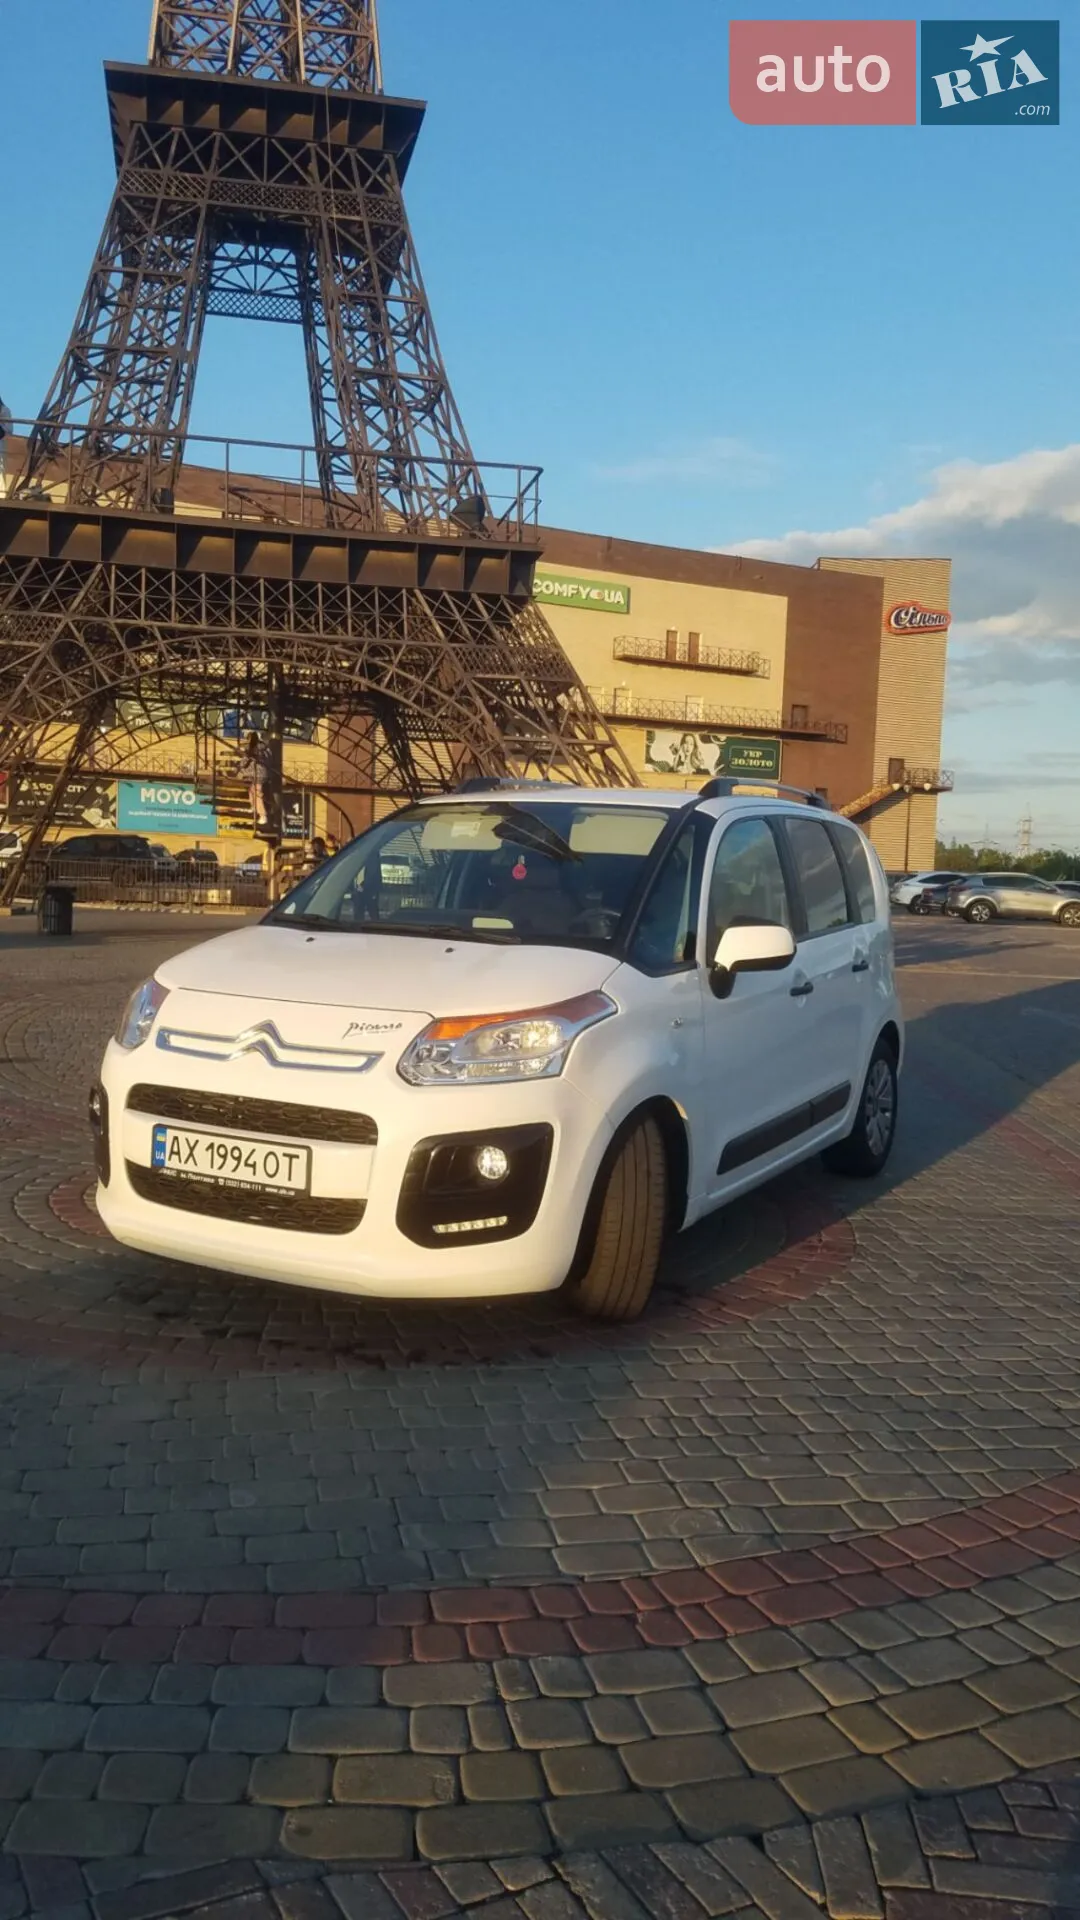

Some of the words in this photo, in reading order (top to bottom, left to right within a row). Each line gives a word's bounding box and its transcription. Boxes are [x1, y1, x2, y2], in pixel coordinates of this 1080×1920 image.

[532, 578, 591, 600] COMFY
[140, 787, 196, 806] MOYO
[155, 1150, 165, 1161] UA
[168, 1135, 200, 1167] AX
[205, 1141, 257, 1177] 1994
[263, 1150, 301, 1182] OT
